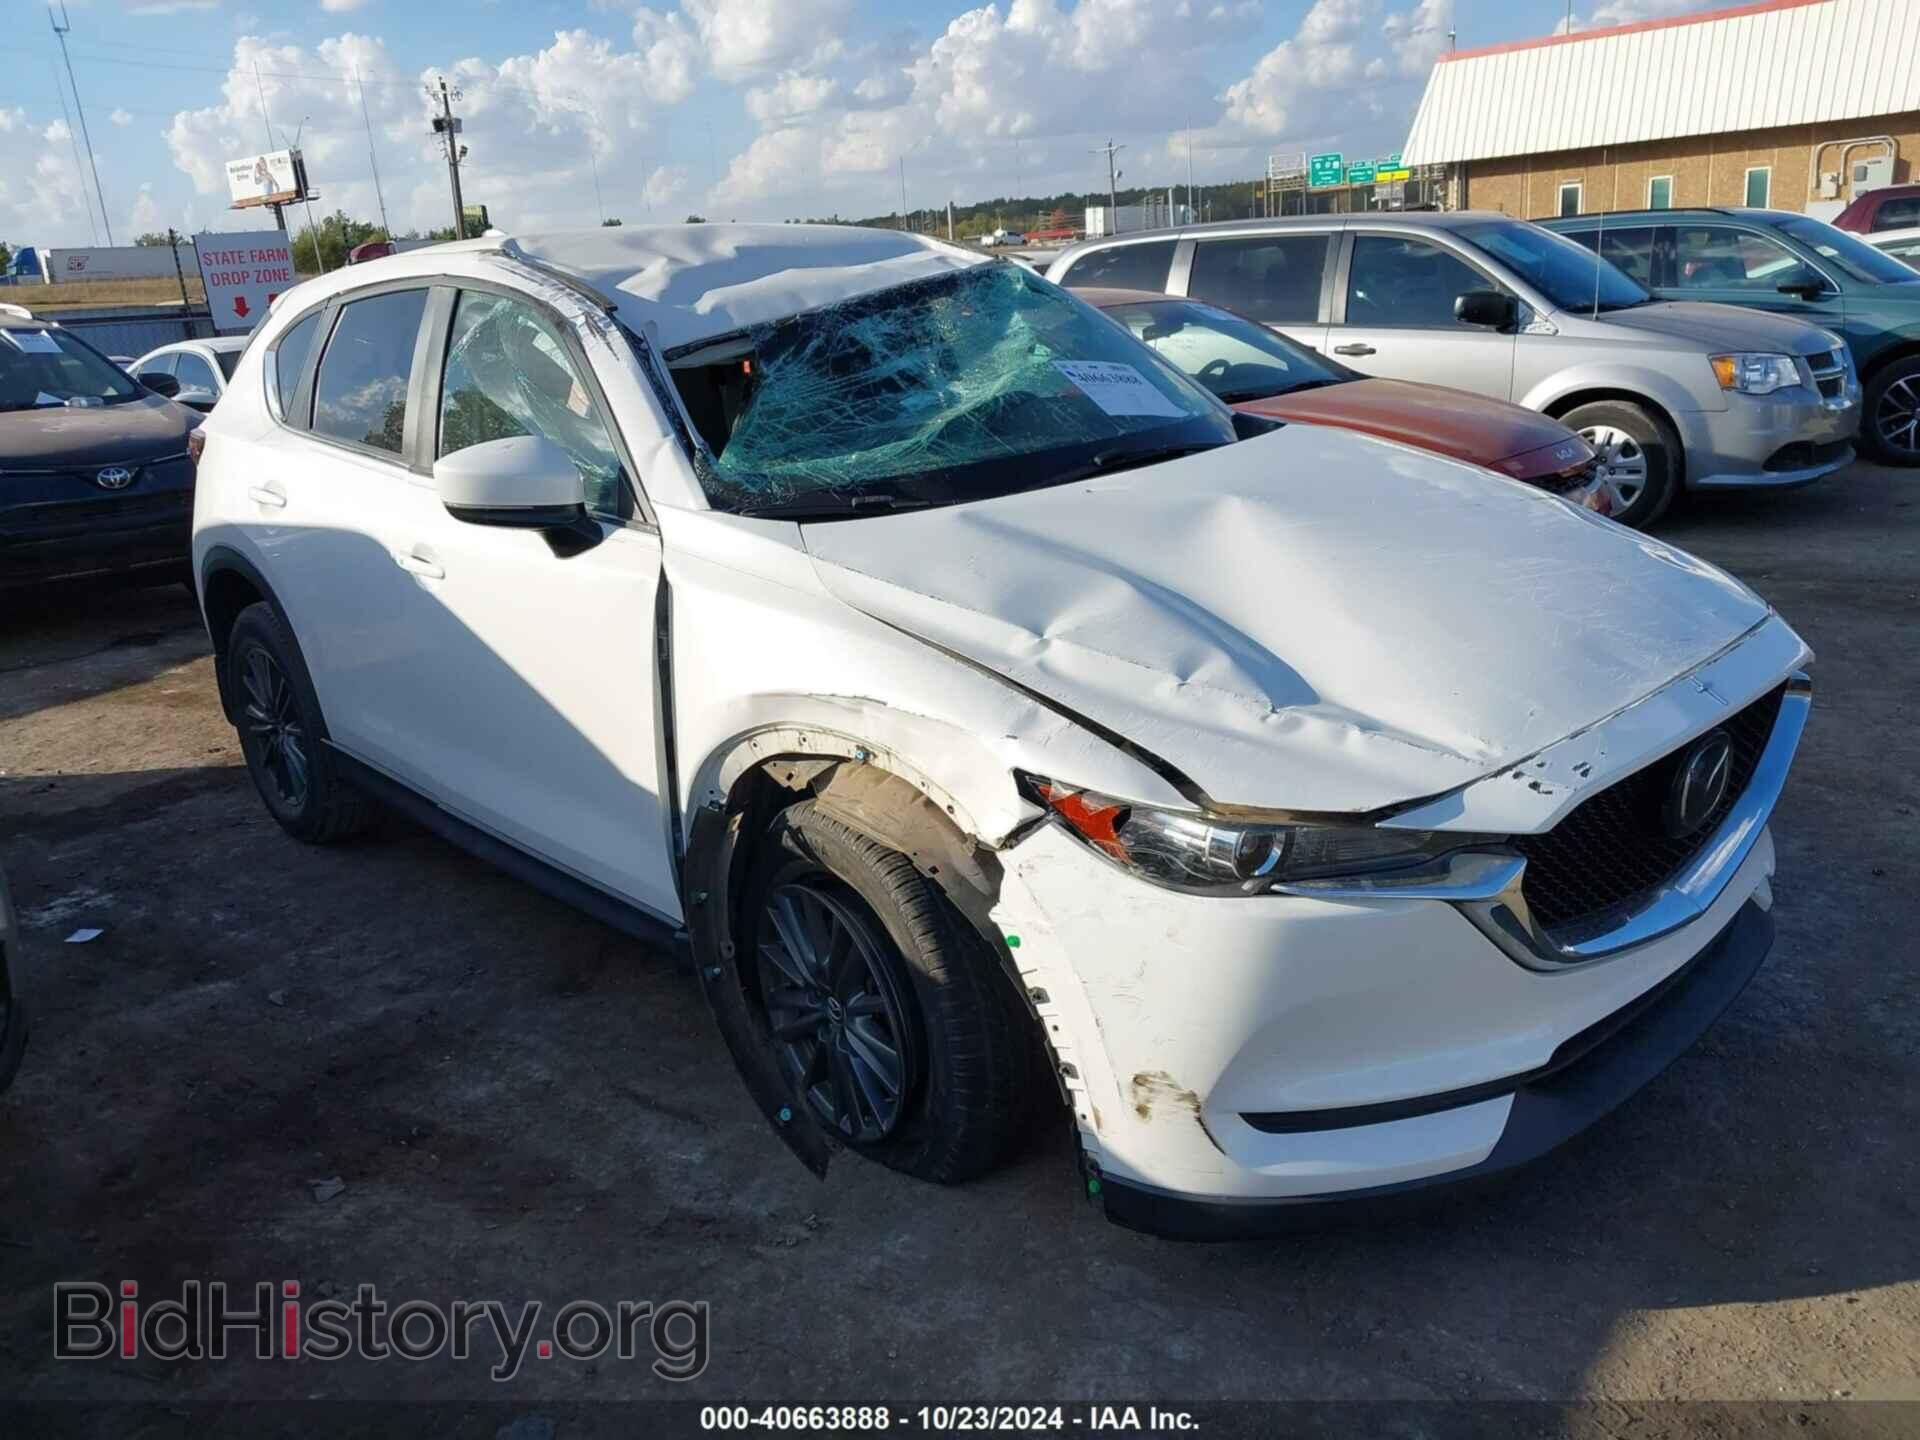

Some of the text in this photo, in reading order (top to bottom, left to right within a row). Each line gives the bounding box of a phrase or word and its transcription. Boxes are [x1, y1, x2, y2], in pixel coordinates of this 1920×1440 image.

[202, 247, 289, 266] STATE FARM
[210, 268, 290, 287] DROP ZONE
